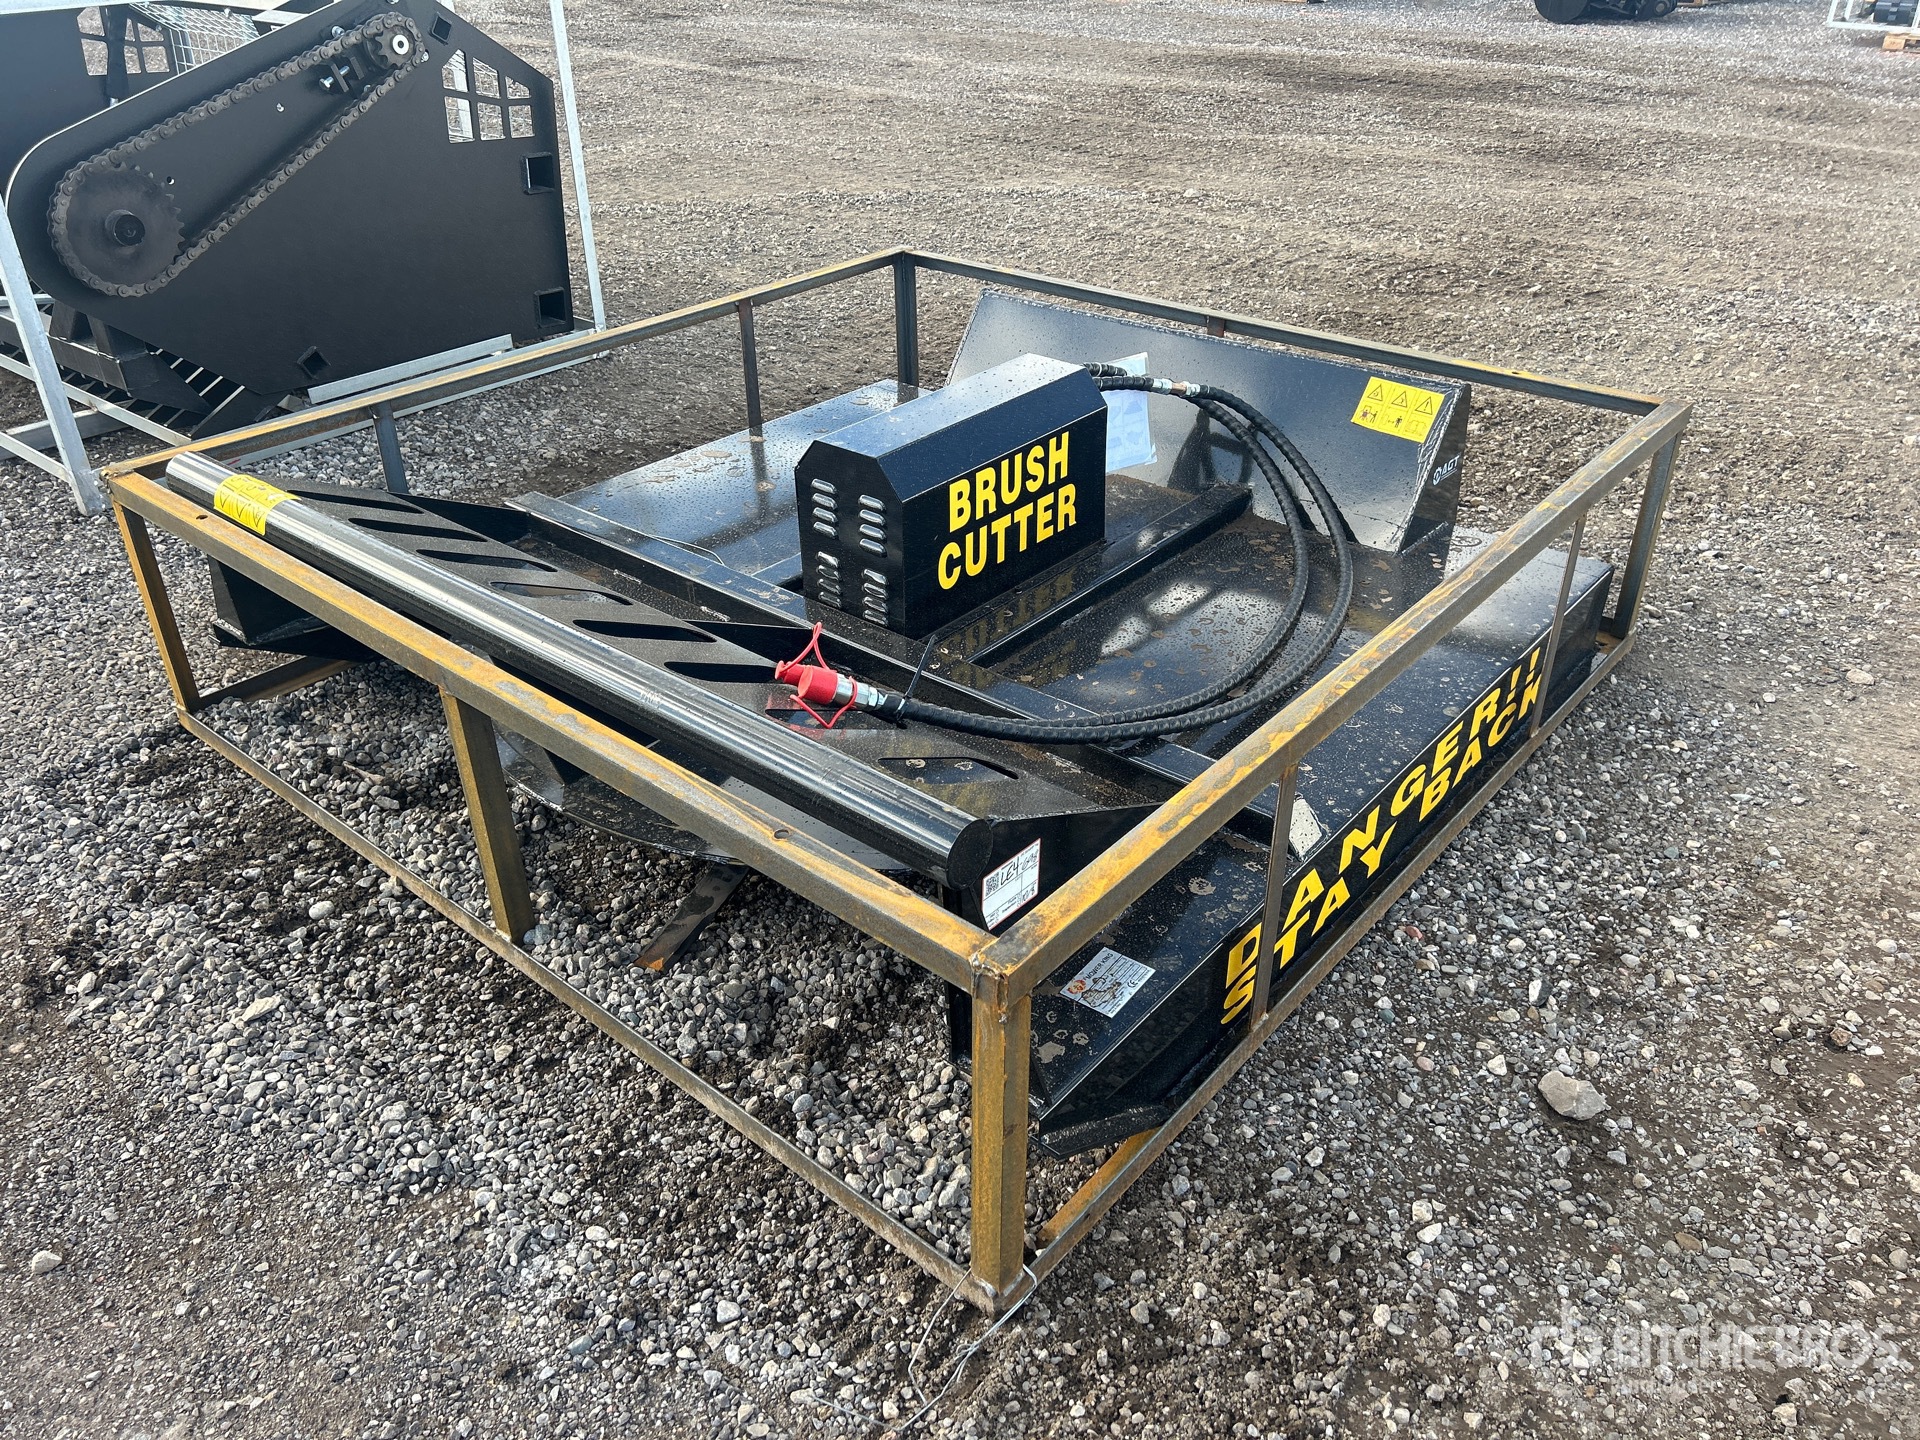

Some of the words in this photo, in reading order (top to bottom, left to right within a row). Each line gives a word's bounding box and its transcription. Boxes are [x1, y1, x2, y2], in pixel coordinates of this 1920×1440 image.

[949, 431, 1069, 533] BRUSH
[1441, 454, 1460, 475] AGT
[938, 483, 1077, 590] CUTTER
[1221, 821, 1398, 1025] STAY
[1419, 673, 1542, 822] BACK
[1225, 647, 1541, 989] DANGER!!
